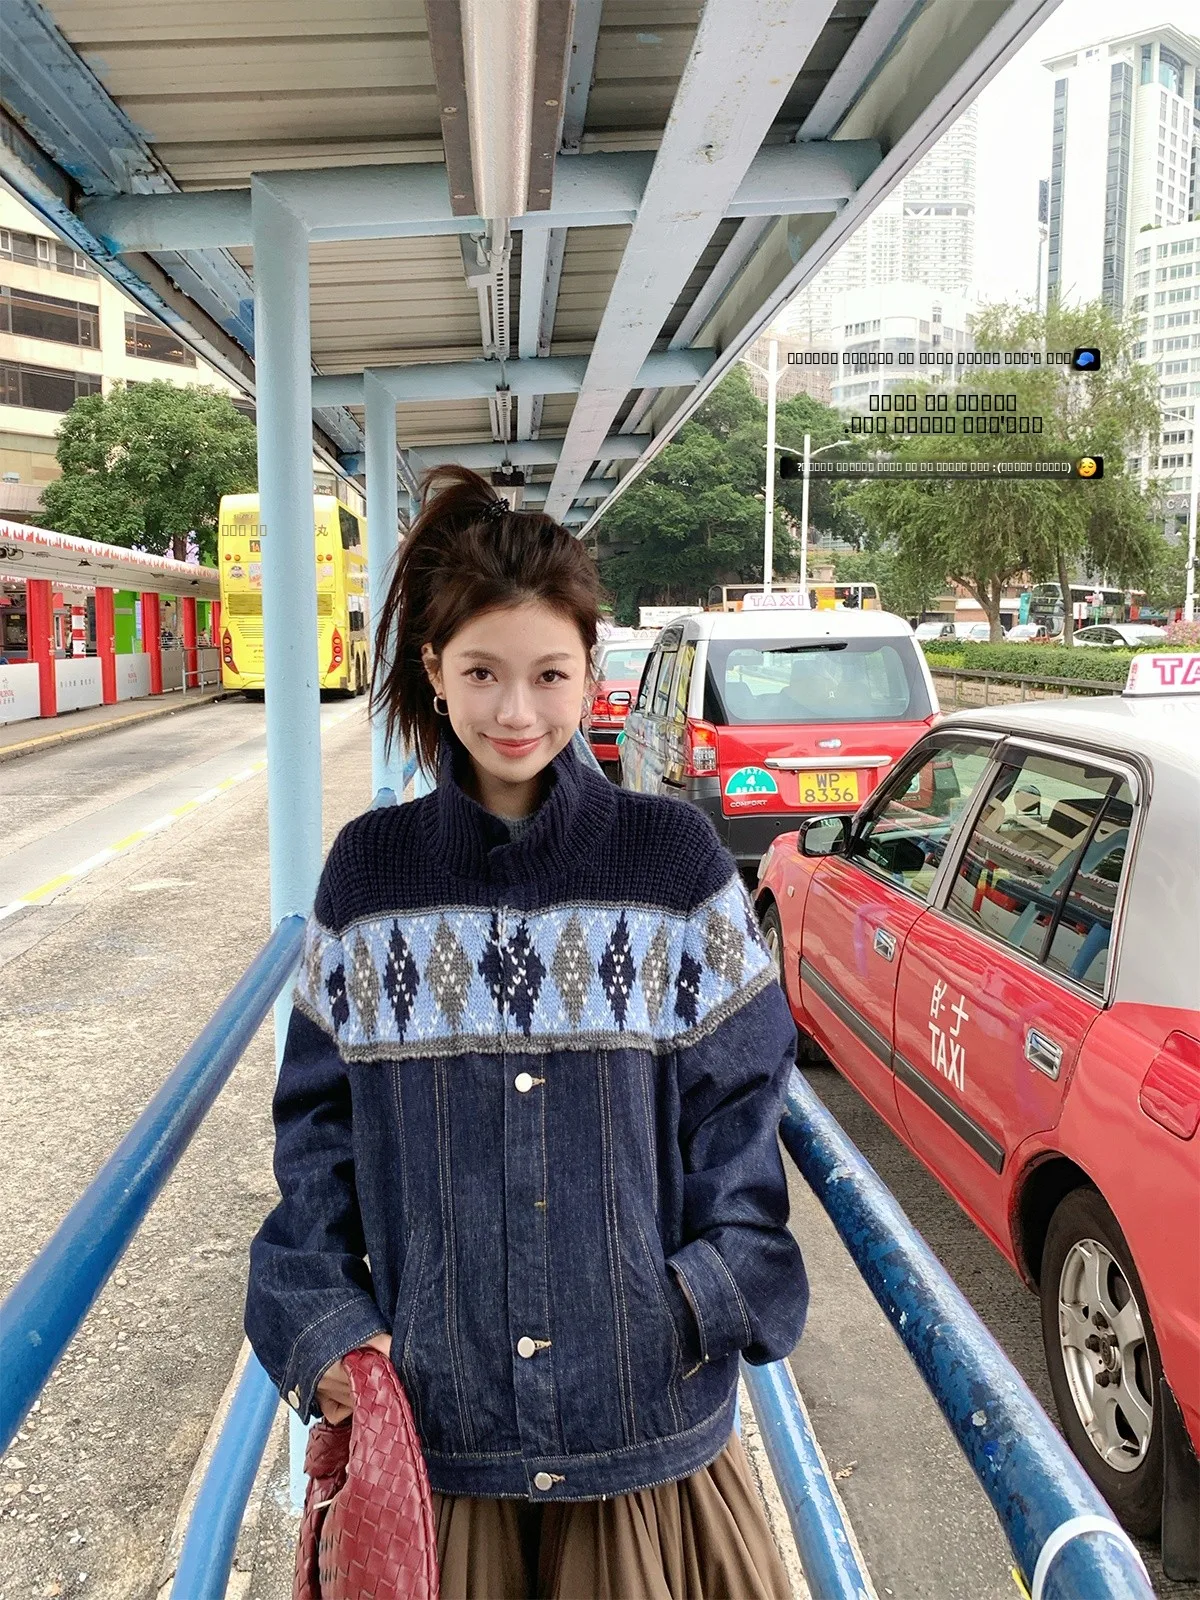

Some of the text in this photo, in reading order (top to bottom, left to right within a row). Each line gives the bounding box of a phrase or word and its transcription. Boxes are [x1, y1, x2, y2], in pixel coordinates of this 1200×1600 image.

[750, 594, 804, 607] TAXI
[746, 774, 756, 787] 4
[816, 773, 840, 787] WP
[804, 787, 854, 803] 8336
[730, 799, 768, 808] COMFORT
[930, 978, 969, 1037] 的士
[928, 1021, 966, 1092] TAXI
